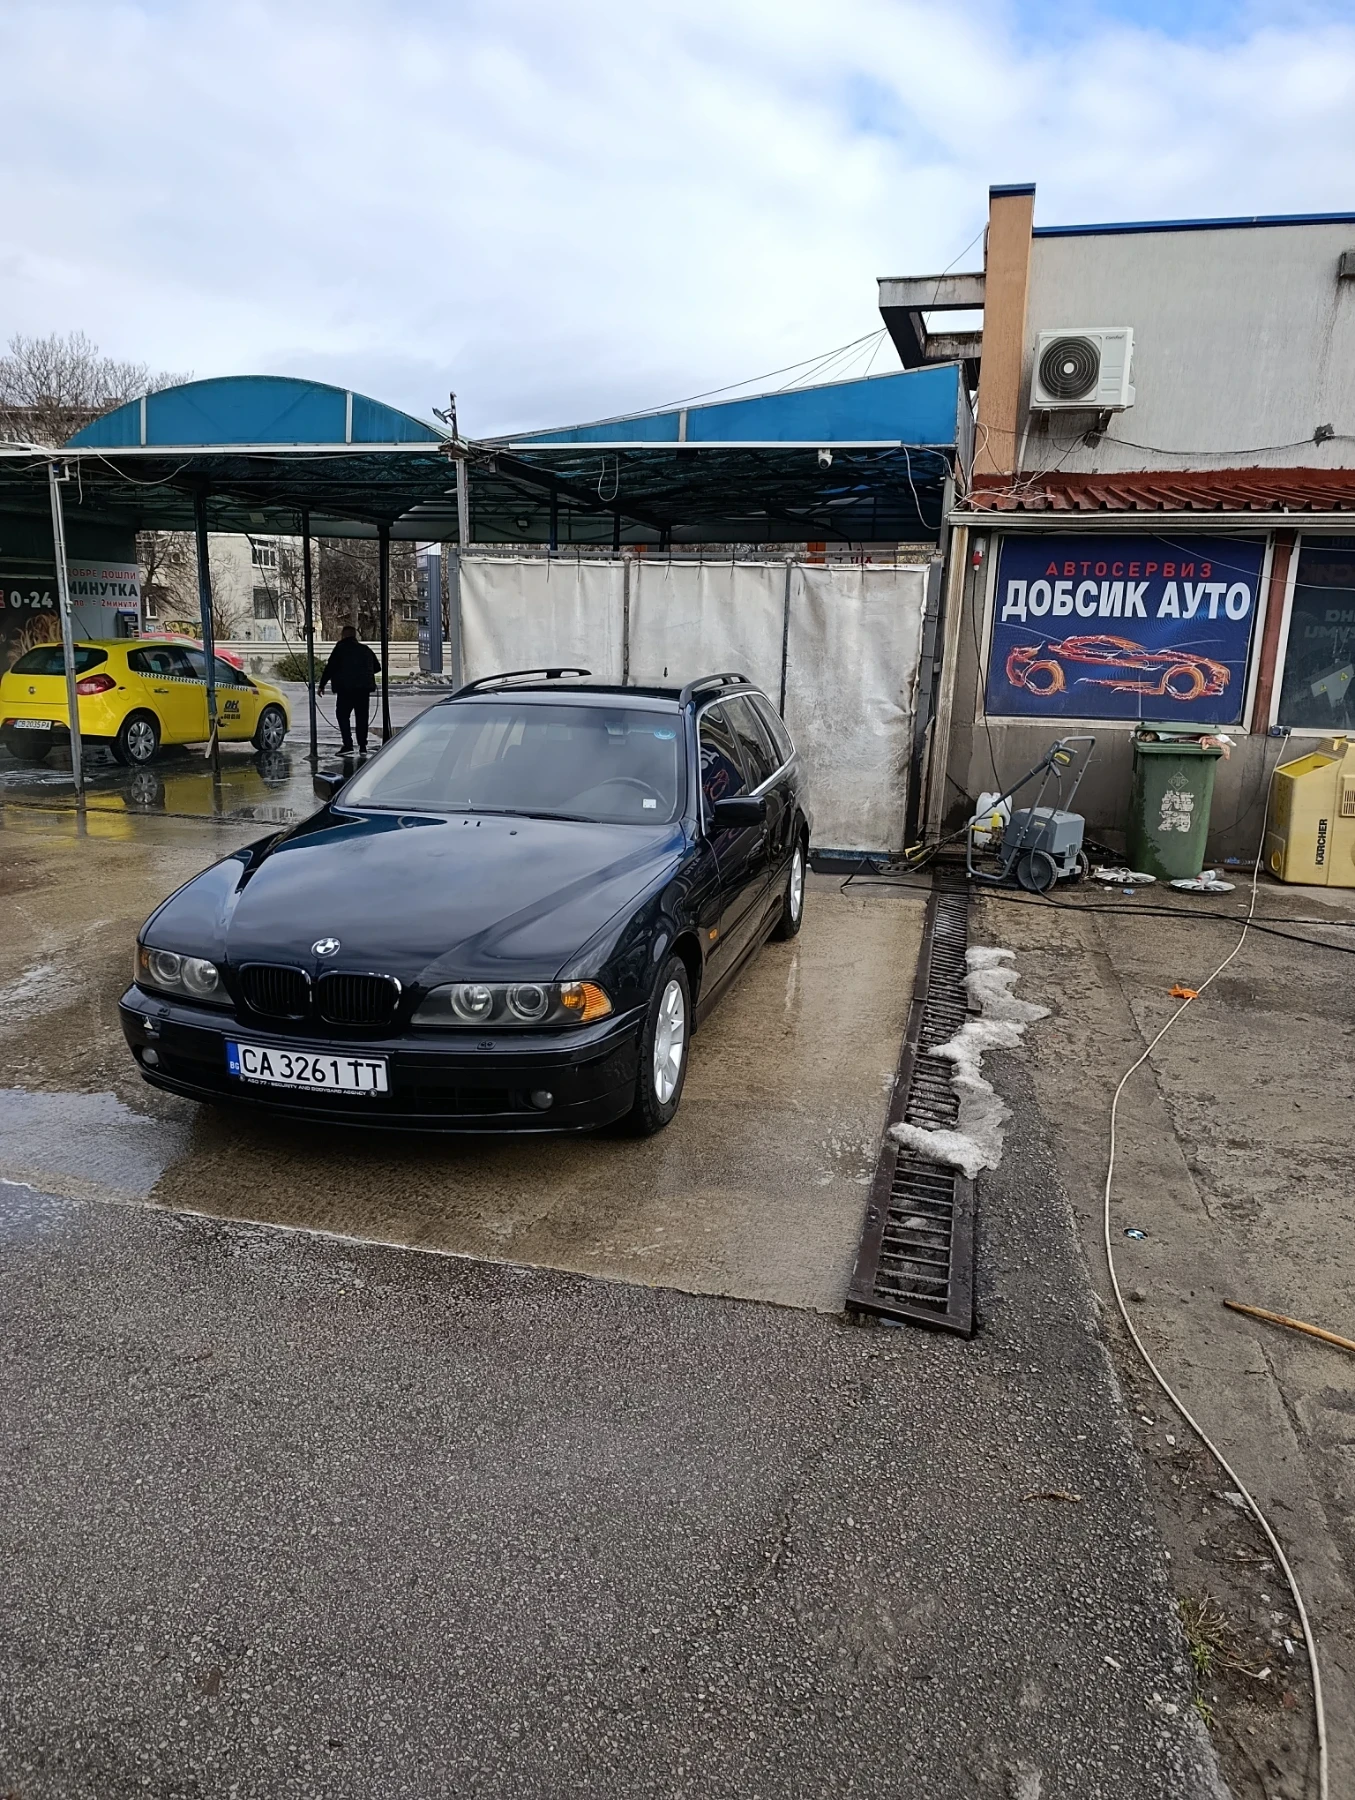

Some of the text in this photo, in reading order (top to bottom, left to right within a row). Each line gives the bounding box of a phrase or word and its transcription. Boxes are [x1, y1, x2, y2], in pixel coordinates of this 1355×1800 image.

[101, 570, 136, 579] ДОШЛИ
[1045, 561, 1212, 578] АВТОСЕРВИЗ
[68, 581, 138, 597] МИНУТКА
[10, 590, 53, 608] 0-24
[1001, 579, 1251, 622] ДОБСИК АУТО
[229, 1061, 240, 1070] BG
[242, 1048, 382, 1088] CA 3261 TT
